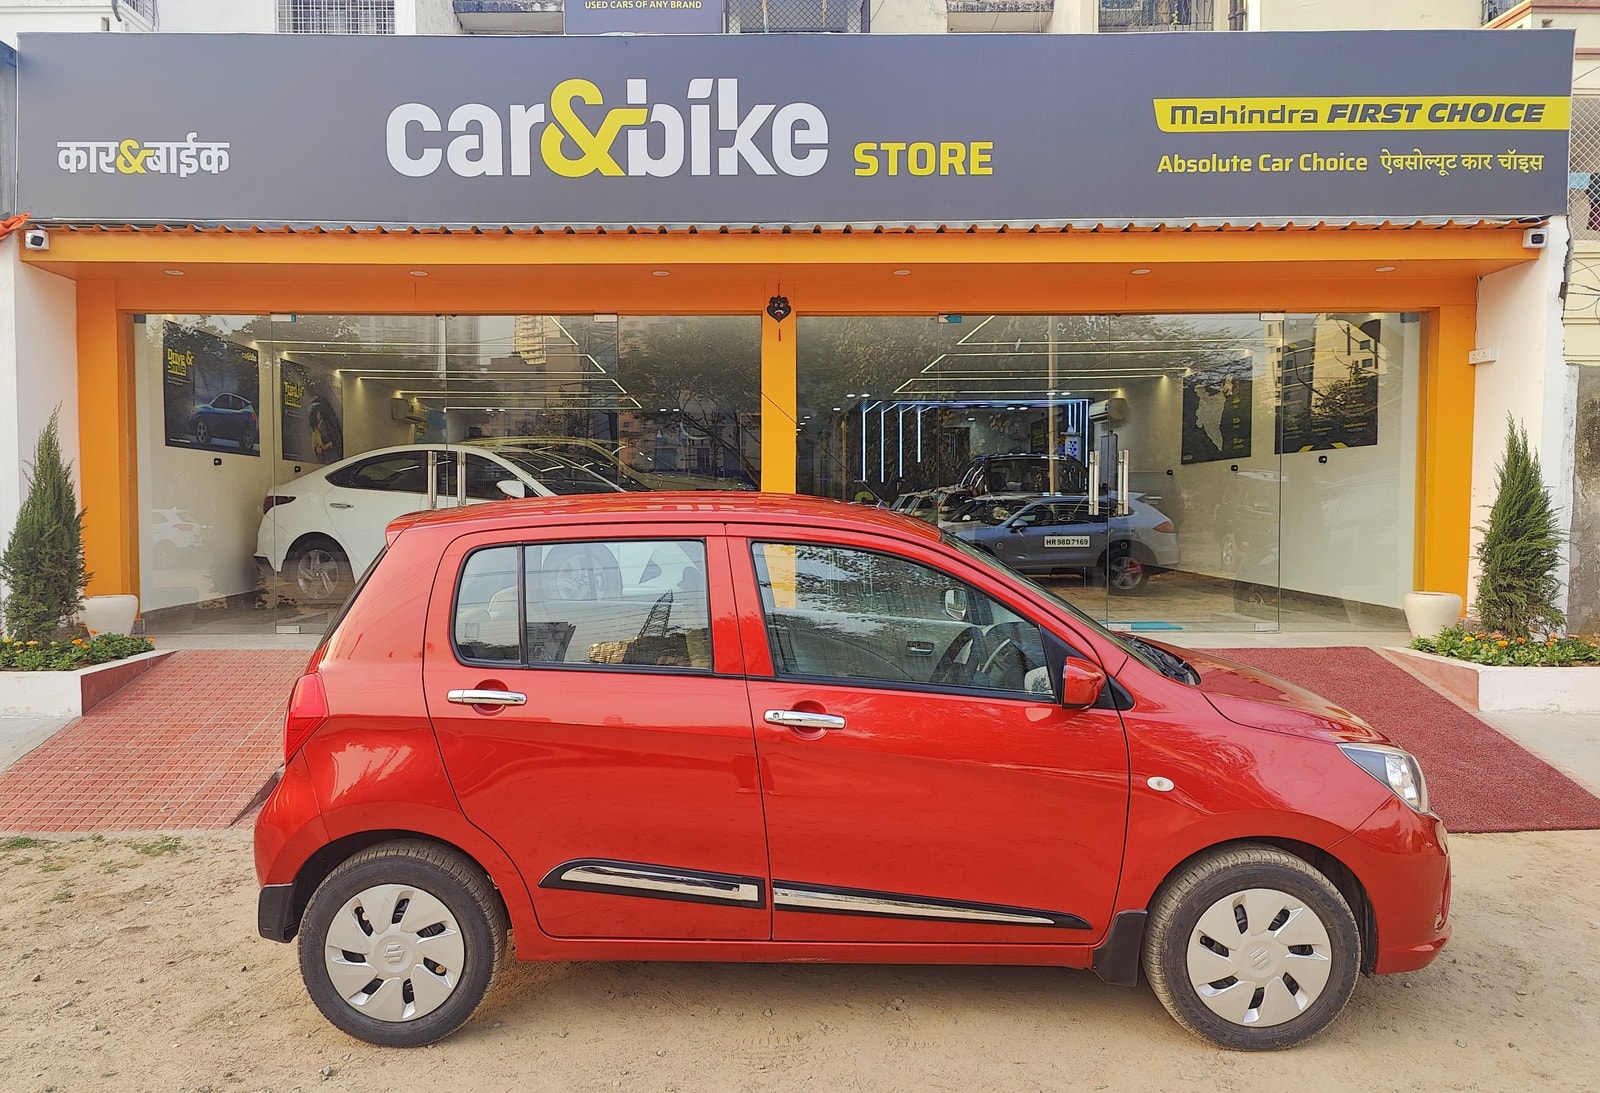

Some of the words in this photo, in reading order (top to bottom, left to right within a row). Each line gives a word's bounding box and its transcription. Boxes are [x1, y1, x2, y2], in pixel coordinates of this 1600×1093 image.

[585, 0, 608, 9] USED
[610, 0, 634, 9] CARS
[635, 0, 648, 9] OF
[649, 0, 668, 9] ANY
[670, 0, 702, 9] BRAND
[1170, 104, 1319, 125] Mahindra
[1326, 103, 1423, 124] FIRST
[1427, 102, 1546, 123] CHOICE
[385, 78, 829, 178] car&bike
[853, 141, 994, 177] STORE
[1157, 153, 1252, 173] Absolute
[1258, 152, 1294, 172] Car
[1299, 151, 1368, 172] Choice
[1380, 148, 1458, 176] ऐबसोल्यूट
[1460, 153, 1494, 171] कार
[1497, 148, 1545, 174] चॉइस
[1046, 538, 1089, 546] HR98D7169
